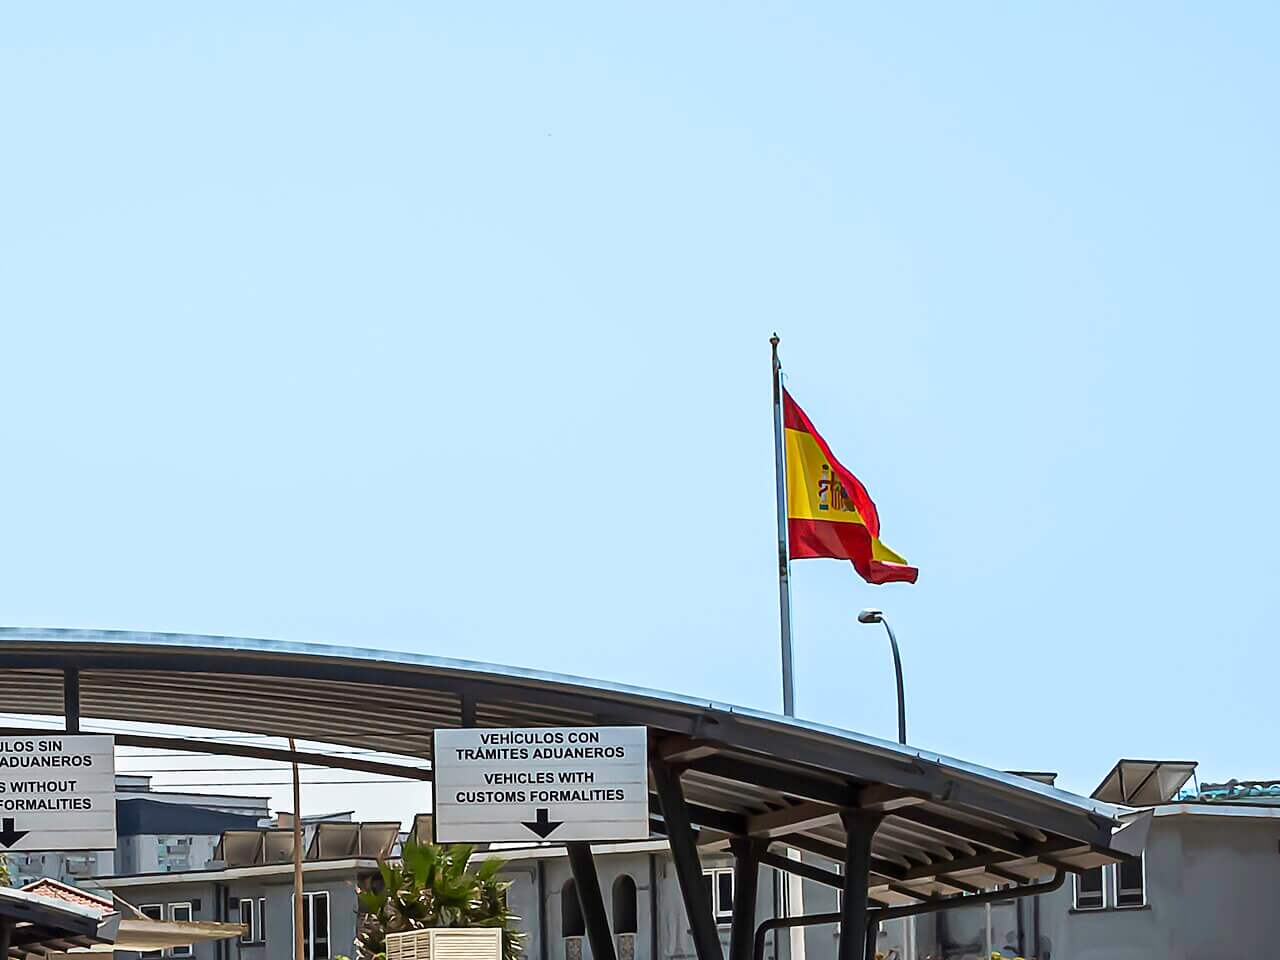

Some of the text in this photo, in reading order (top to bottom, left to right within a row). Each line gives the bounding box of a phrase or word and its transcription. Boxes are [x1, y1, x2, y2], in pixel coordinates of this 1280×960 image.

[481, 731, 599, 744] VEHÍCULOS CON
[39, 741, 62, 752] SIN
[456, 747, 625, 760] TRÁMITES ADUANEROS
[0, 756, 92, 768] ADUANEROS
[484, 772, 594, 784] VEHICLES WITH
[10, 781, 77, 792] WITHOUT
[456, 789, 624, 803] CUSTOMS FORMALITIES
